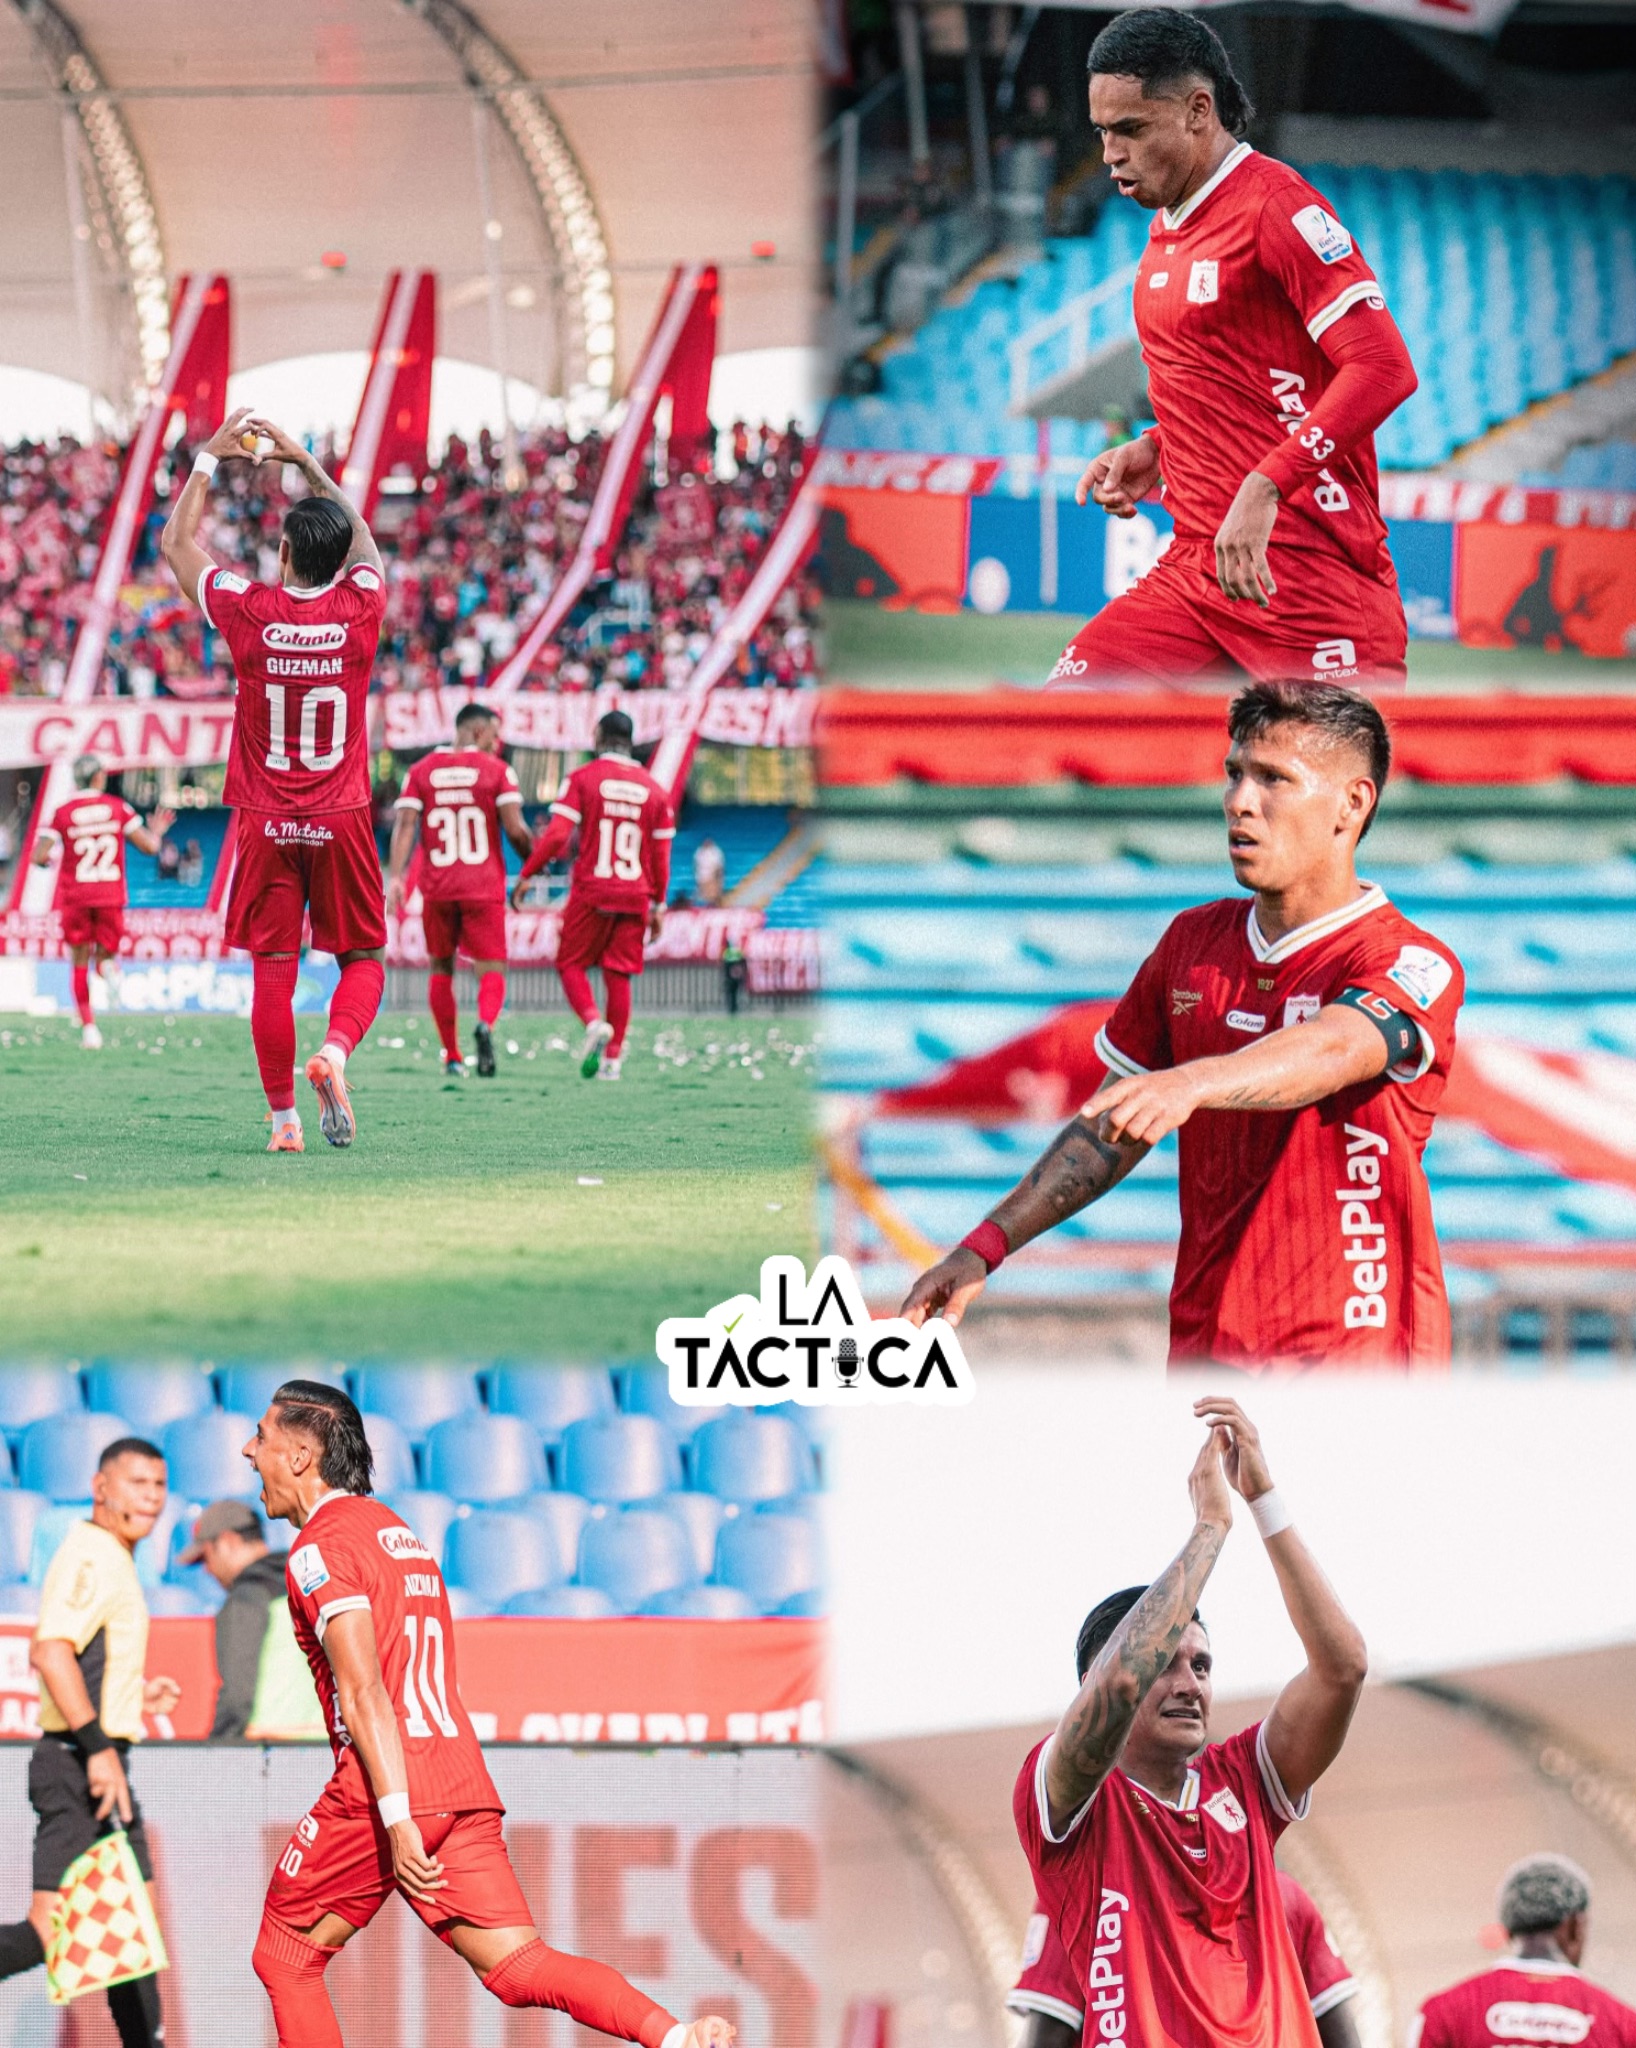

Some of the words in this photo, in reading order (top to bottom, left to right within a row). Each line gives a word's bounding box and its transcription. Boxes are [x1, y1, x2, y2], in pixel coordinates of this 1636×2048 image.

[1300, 426, 1336, 460] 33
[264, 628, 343, 647] Colanta
[266, 657, 343, 676] GUZMAN
[265, 683, 348, 771] 10
[264, 820, 279, 837] la
[426, 805, 490, 868] 30
[593, 818, 643, 881] 19
[73, 833, 122, 883] 22
[1257, 978, 1275, 991] 1927
[1335, 1122, 1389, 1329] BetPlay
[403, 1615, 459, 1738] 10
[279, 1843, 304, 1878] 10
